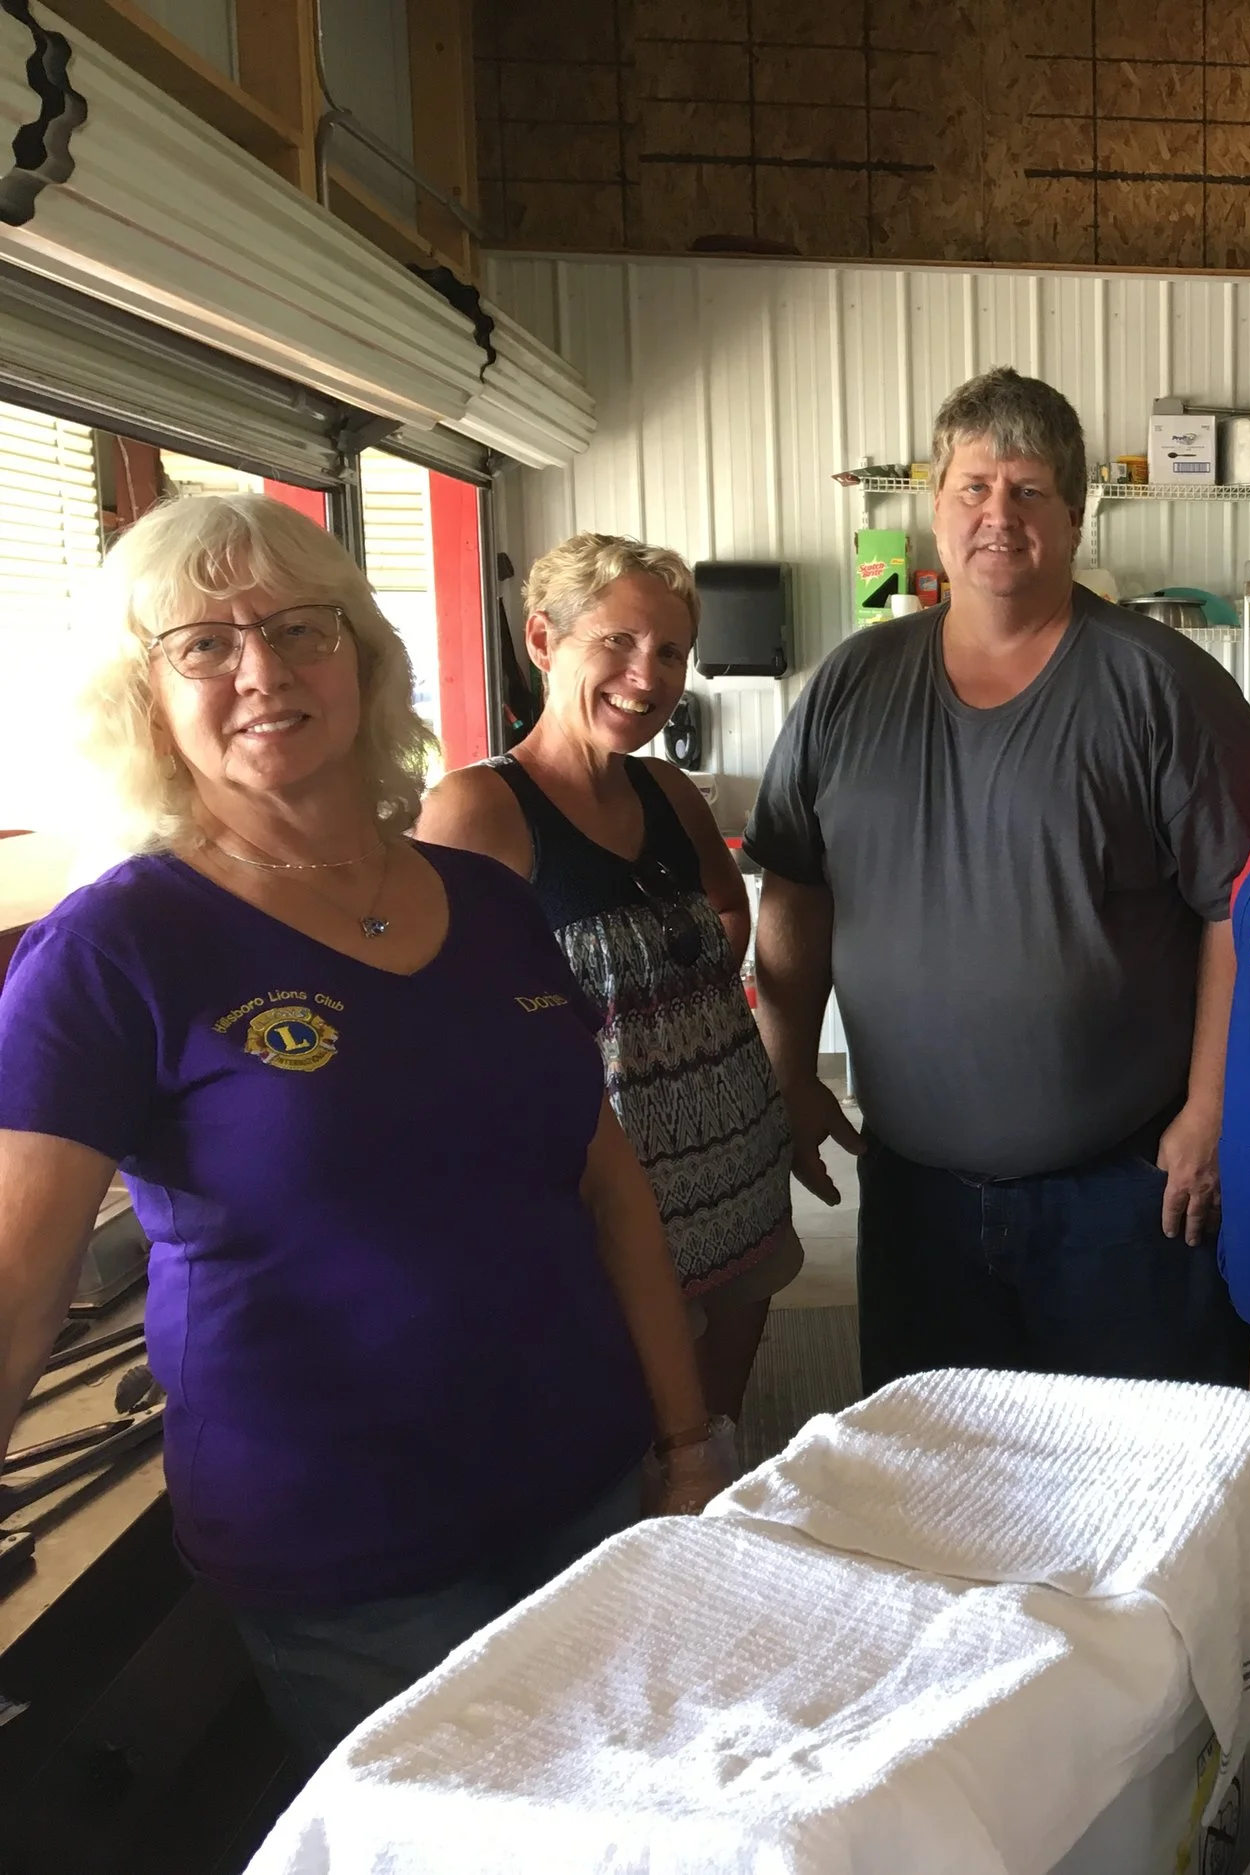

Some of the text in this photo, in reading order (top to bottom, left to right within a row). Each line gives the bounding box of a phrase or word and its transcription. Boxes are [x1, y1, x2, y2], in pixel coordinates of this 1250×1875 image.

[212, 997, 264, 1034] Hillsboro
[267, 989, 307, 1003] Lions
[314, 993, 345, 1012] Club
[274, 1024, 310, 1052] L
